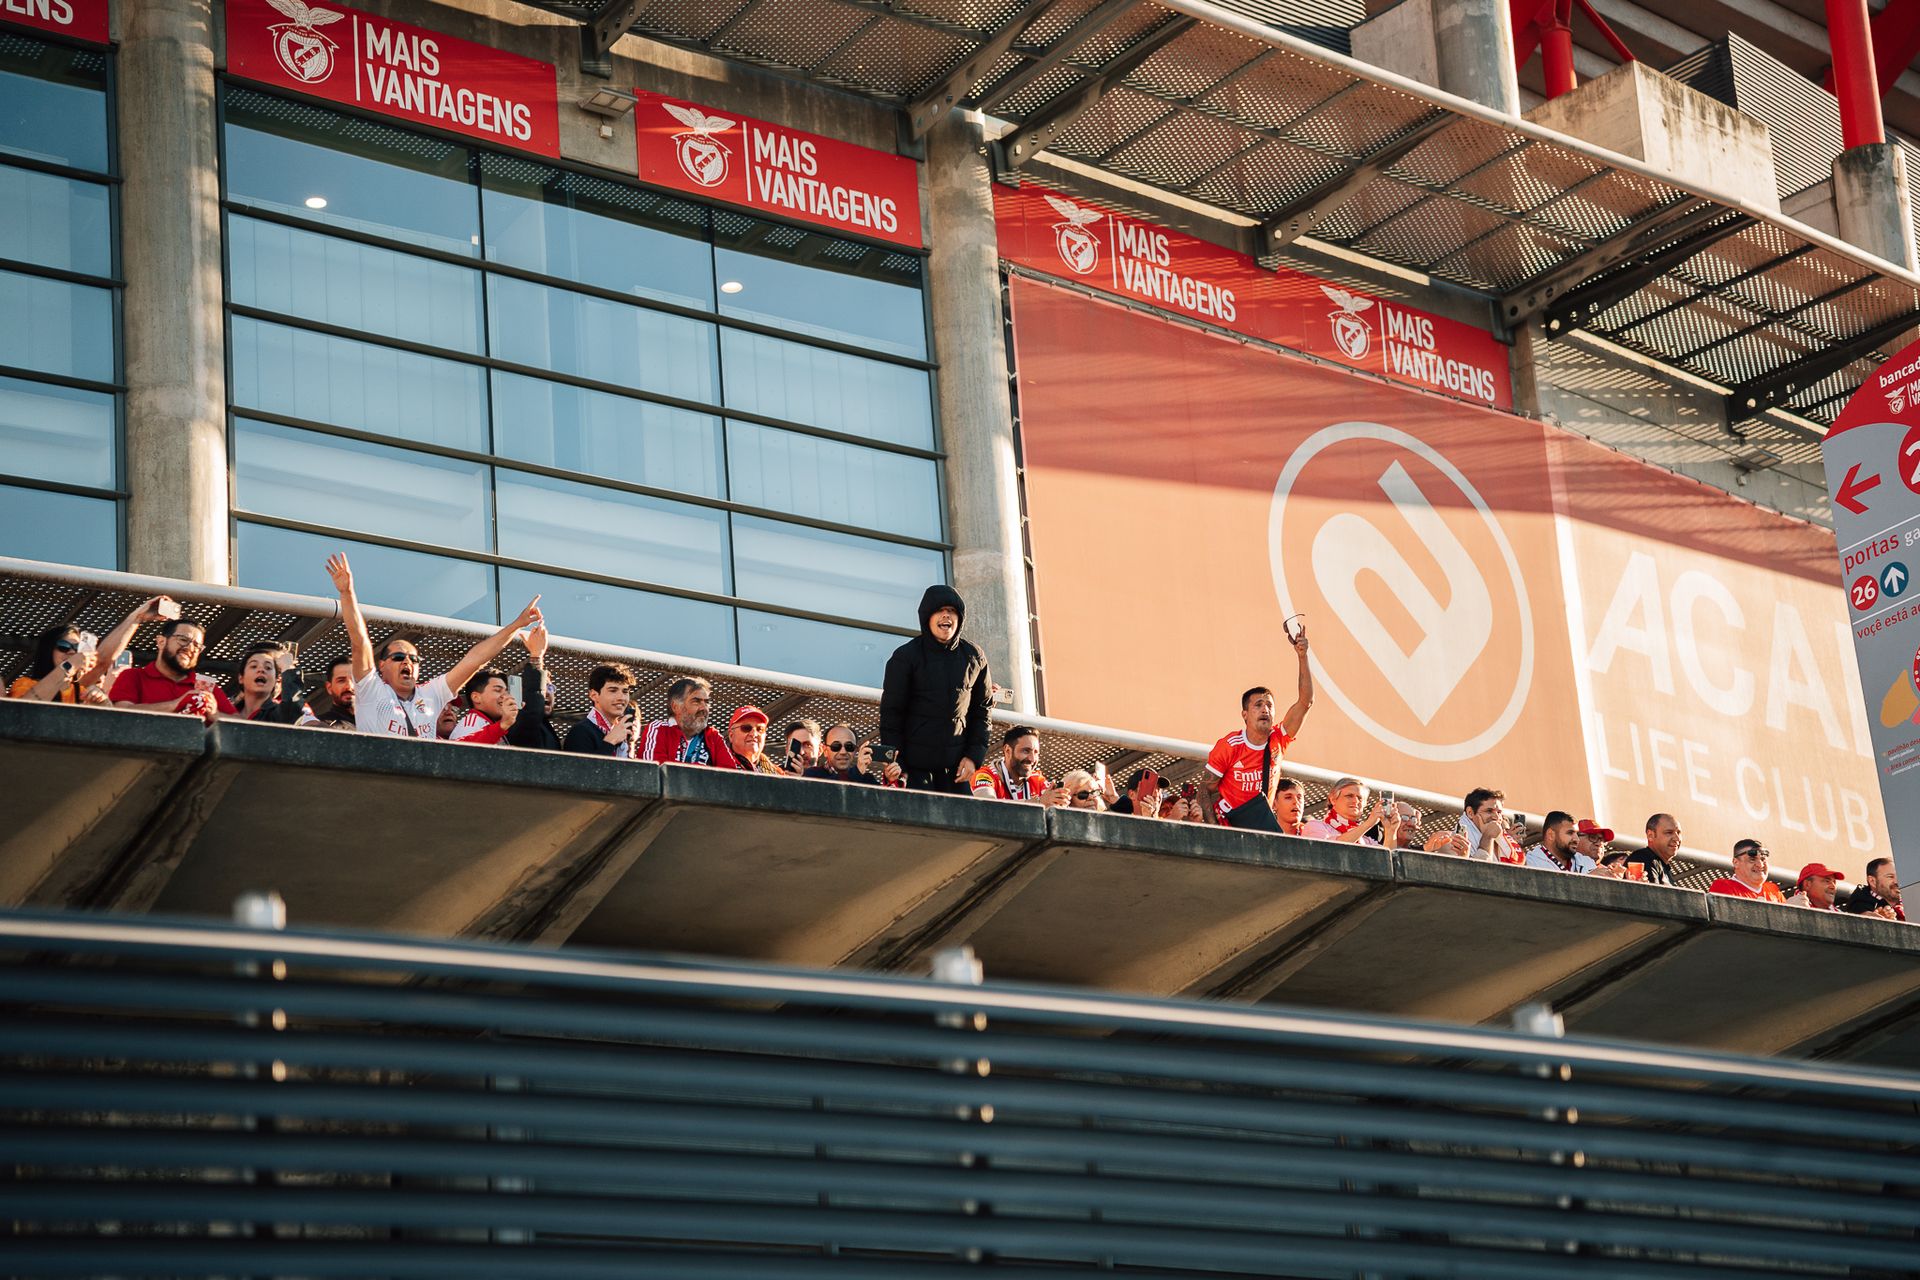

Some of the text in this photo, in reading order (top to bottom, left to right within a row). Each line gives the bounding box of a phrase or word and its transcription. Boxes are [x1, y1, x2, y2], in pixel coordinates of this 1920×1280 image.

[366, 25, 440, 76] MAIS
[366, 63, 531, 142] VANTAGENS
[753, 128, 818, 176] MAIS
[755, 165, 898, 233] VANTAGENS
[1118, 221, 1169, 266] MAIS
[1119, 256, 1236, 321] VANTAGENS
[1387, 307, 1434, 350] MAIS
[1389, 341, 1494, 400] VANTAGENS
[1844, 534, 1900, 575] portas
[1852, 579, 1876, 606] 26
[1857, 618, 1882, 640] voçê
[1884, 607, 1909, 628] está
[388, 719, 431, 737] Emtes
[1234, 770, 1263, 782] Emir
[1594, 711, 1874, 851] LIFE CLUB
